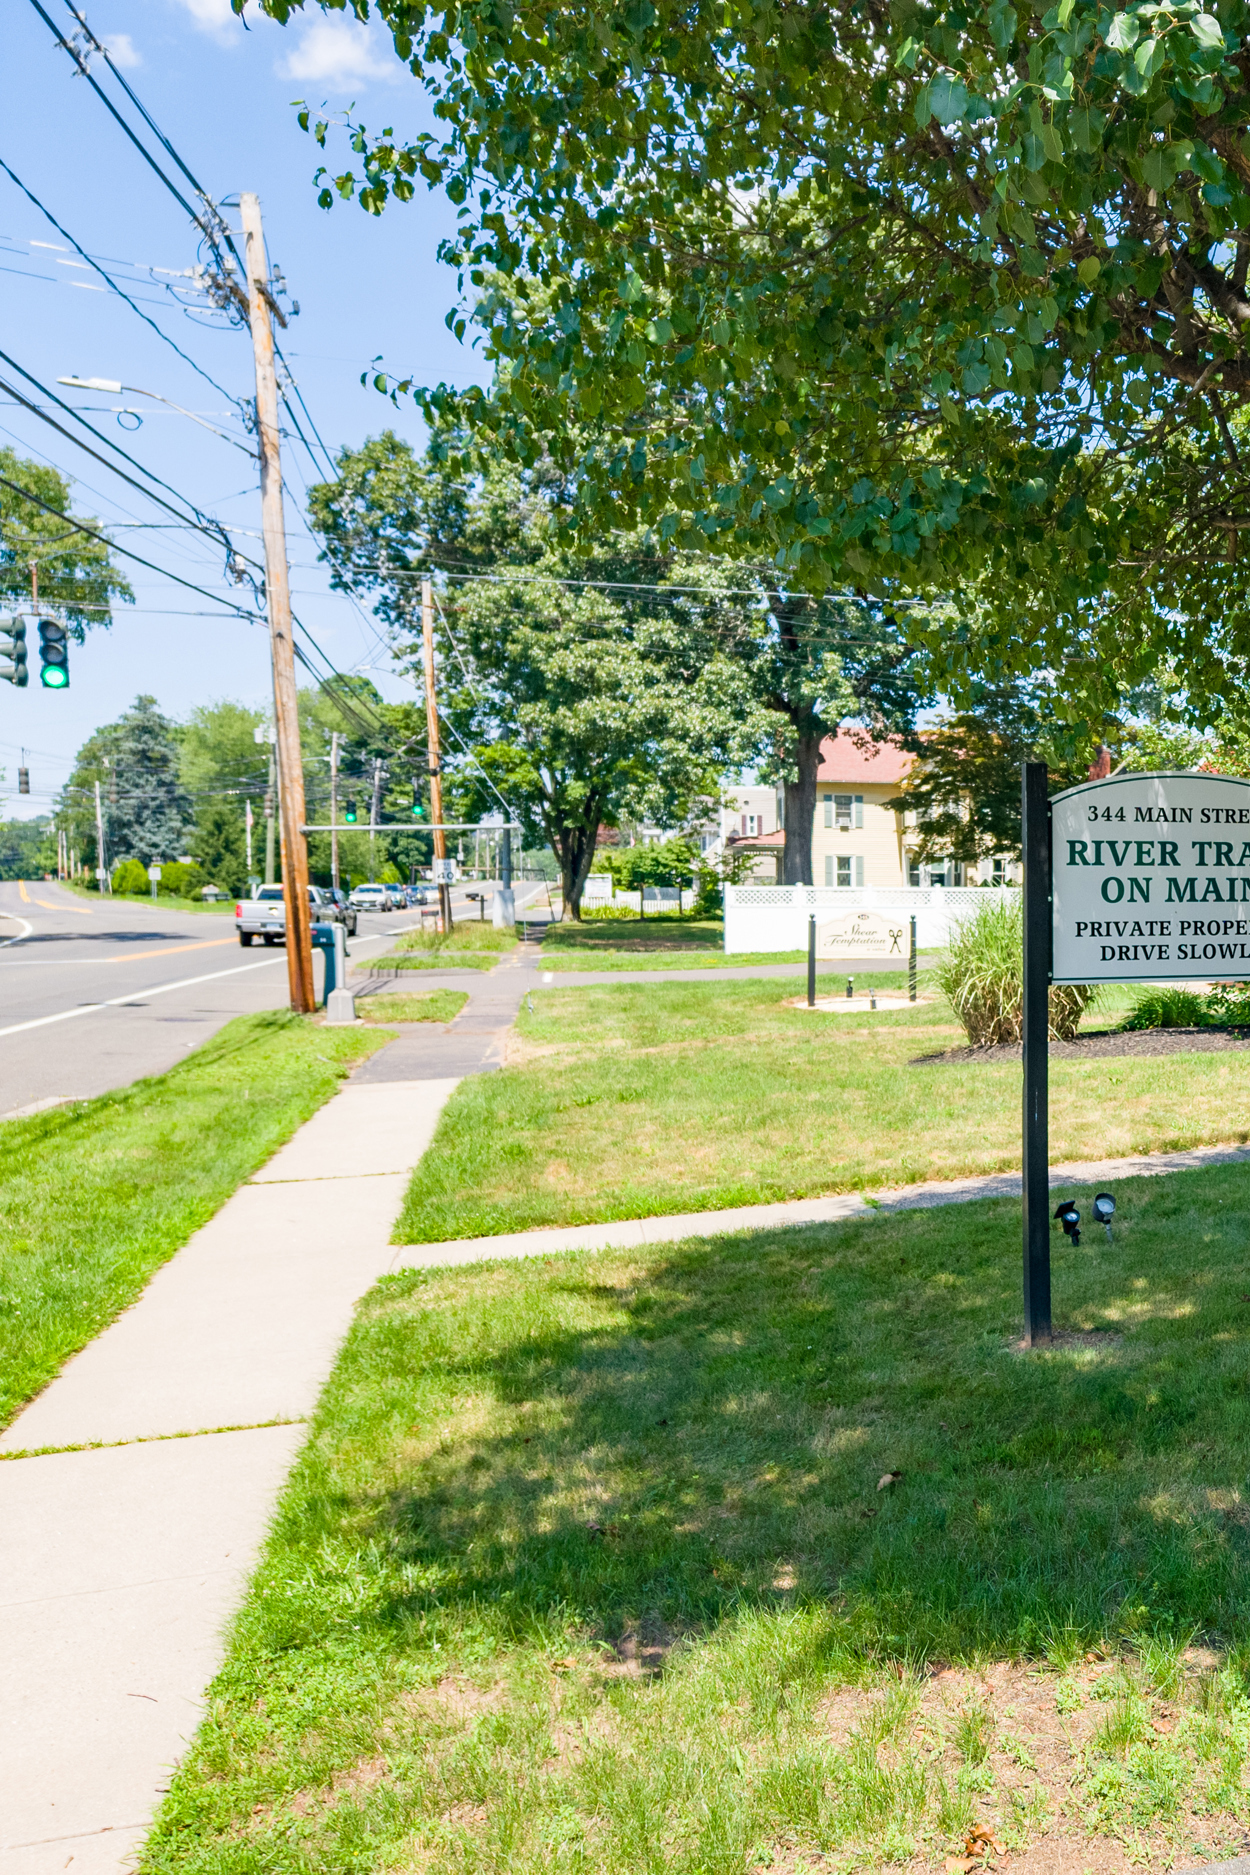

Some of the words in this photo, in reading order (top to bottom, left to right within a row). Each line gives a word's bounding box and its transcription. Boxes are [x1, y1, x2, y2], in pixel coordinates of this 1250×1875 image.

[1087, 805, 1126, 822] 344
[1134, 806, 1193, 823] MAIN
[1066, 839, 1181, 867] RIVER
[1101, 876, 1153, 904] ON
[844, 923, 878, 935] Shear
[1075, 920, 1172, 937] PRIVATE
[823, 935, 886, 947] Temptation
[1100, 944, 1170, 961] DRIVE
